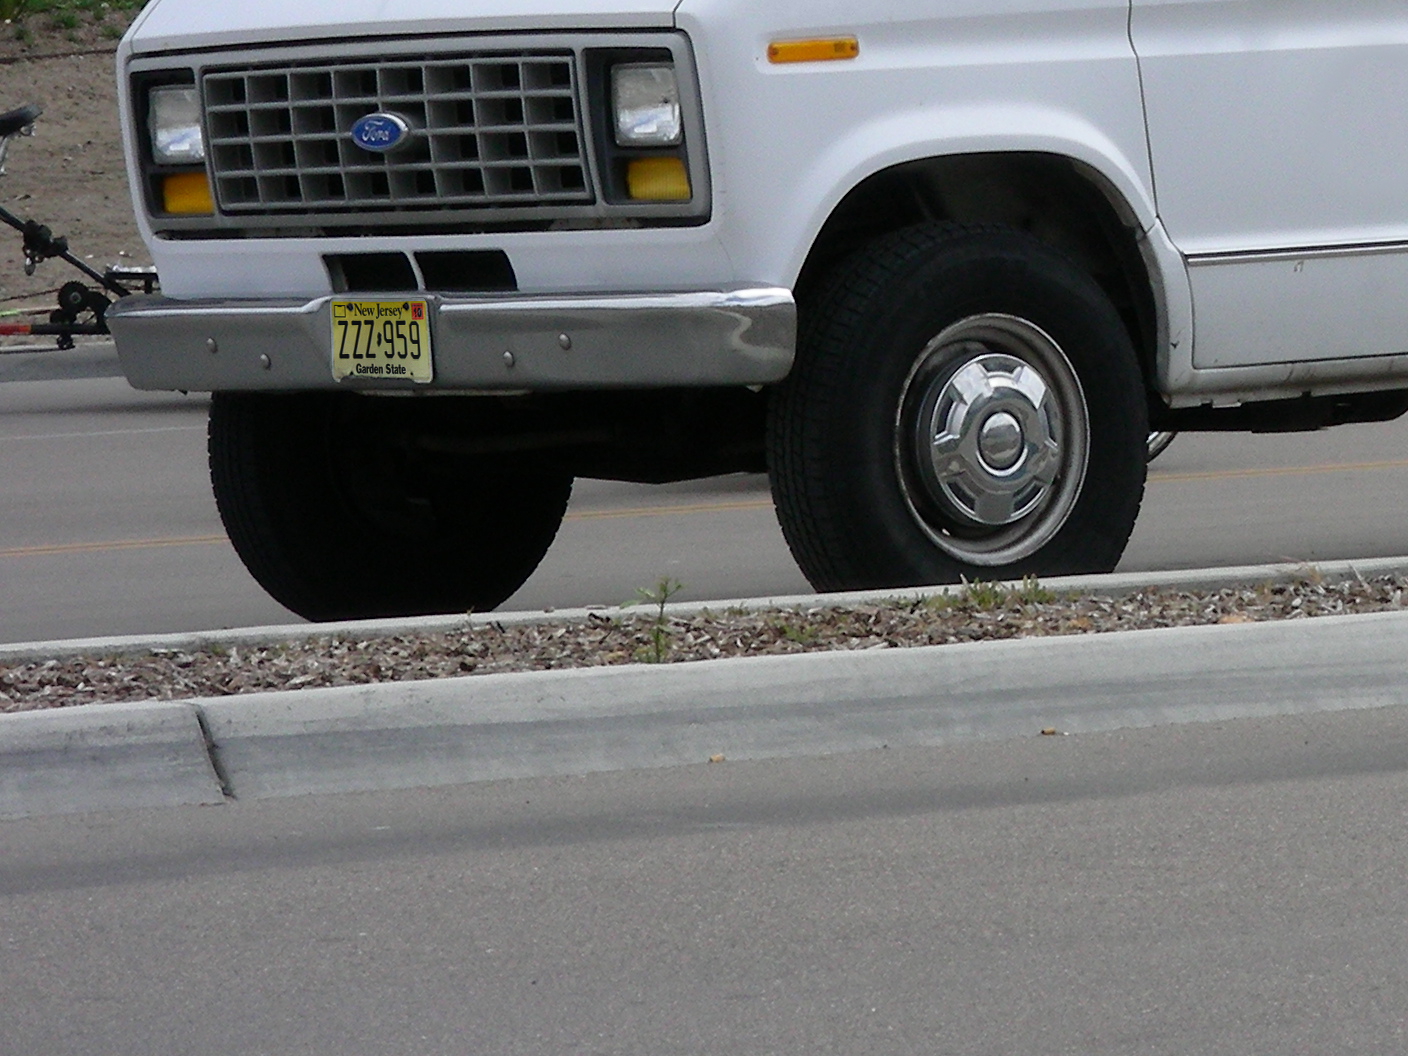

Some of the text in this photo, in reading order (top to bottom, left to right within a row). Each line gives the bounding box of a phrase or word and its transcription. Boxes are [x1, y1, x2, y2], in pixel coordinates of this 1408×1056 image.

[362, 120, 391, 142] Ford
[354, 303, 403, 319] New Jersey
[356, 363, 406, 375] Garden State
